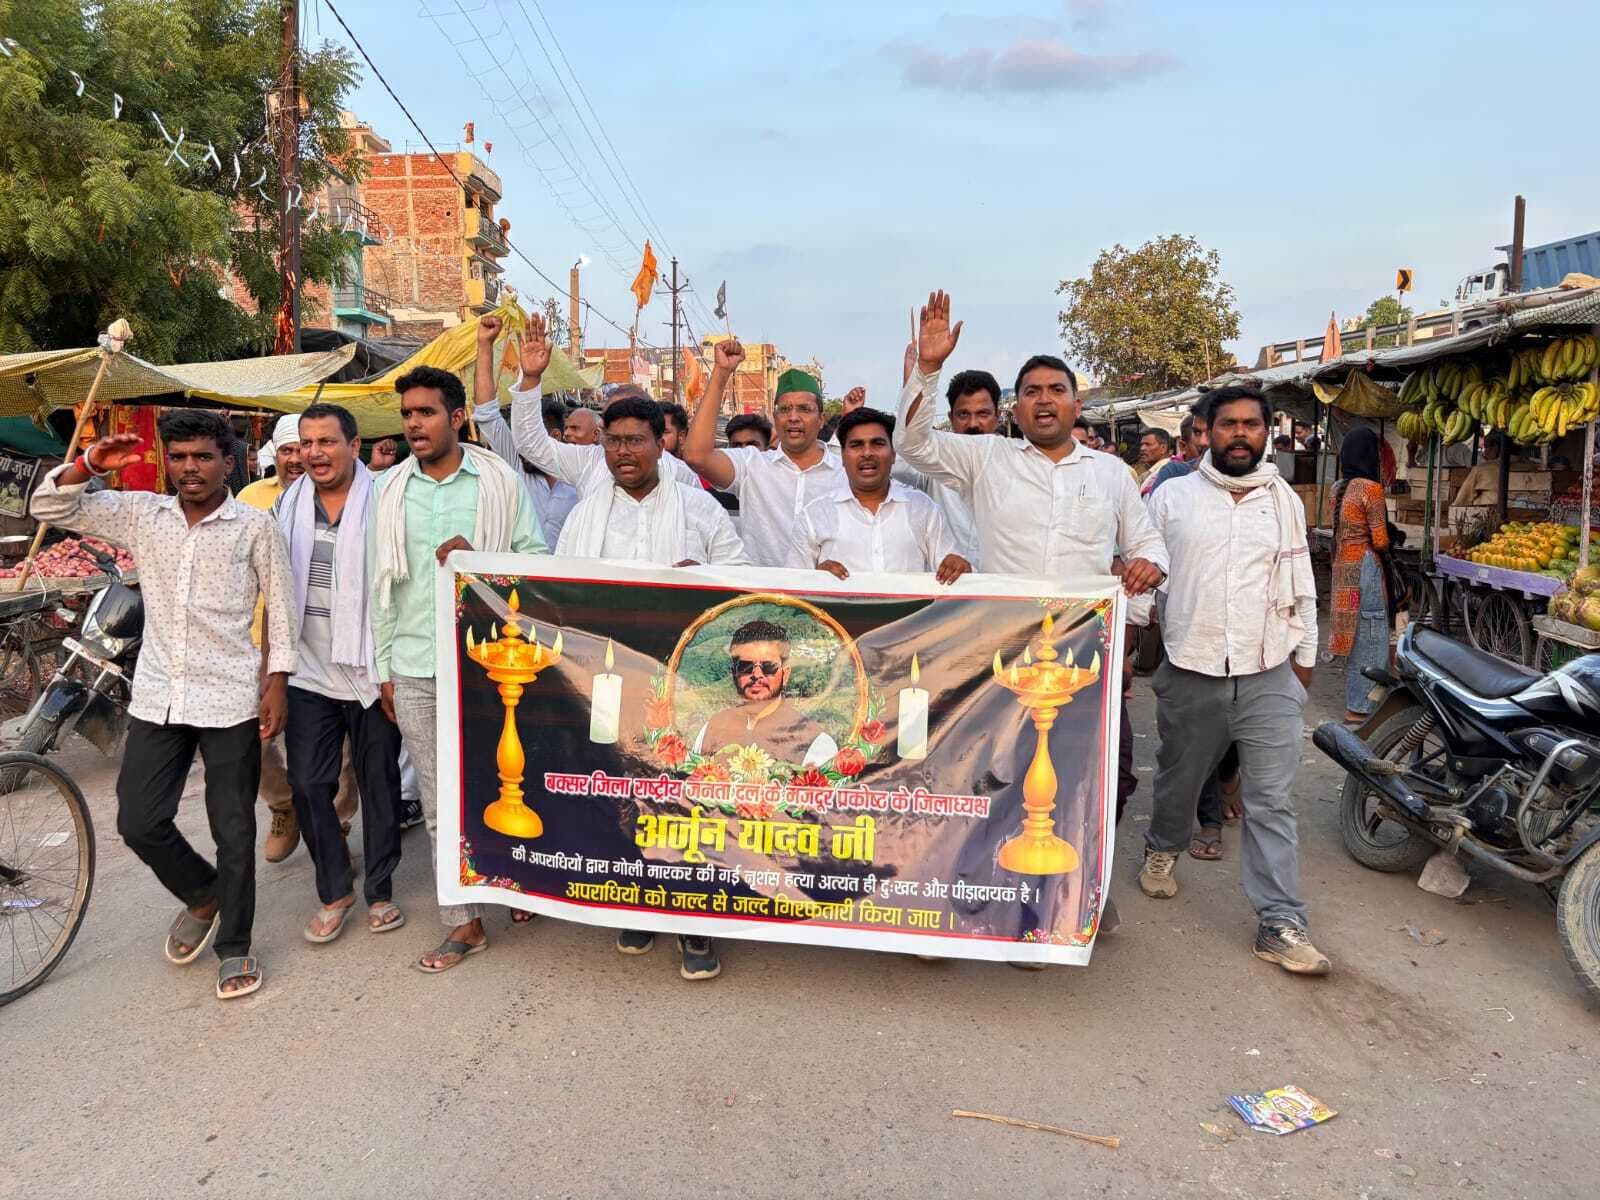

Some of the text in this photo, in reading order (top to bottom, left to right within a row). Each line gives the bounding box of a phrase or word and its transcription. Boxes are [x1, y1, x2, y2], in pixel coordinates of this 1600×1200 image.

[544, 772, 591, 795] बक्सर
[591, 770, 632, 798] जिला
[633, 773, 684, 803] राष्ट्रीय
[685, 780, 732, 801] जनता
[735, 783, 761, 803] दल
[763, 778, 784, 803] के
[784, 785, 835, 813] मजदूर
[890, 785, 912, 812] के
[912, 787, 991, 818] जिलाध्यक्ष
[634, 806, 877, 863] अर्जून यादव जी
[512, 845, 526, 862] की
[529, 851, 583, 872] अपराधियों
[585, 858, 609, 874] द्वारा
[612, 857, 644, 877] गोली
[647, 864, 693, 881] मारकर
[696, 863, 715, 882] की
[718, 864, 742, 886] गई
[744, 868, 780, 890] नृशंस
[784, 872, 815, 889] हत्या
[818, 873, 859, 892] अत्यंत
[863, 873, 877, 893] ही
[922, 877, 949, 898] और
[952, 880, 1019, 904] पीड़ादायक
[1020, 881, 1032, 904] है
[565, 879, 641, 904] अपराधियों
[644, 885, 667, 907] को
[671, 890, 708, 911] जल्द
[712, 888, 728, 912] से
[732, 895, 770, 915] जल्द
[859, 899, 902, 926] किया
[907, 908, 942, 929] जाए
